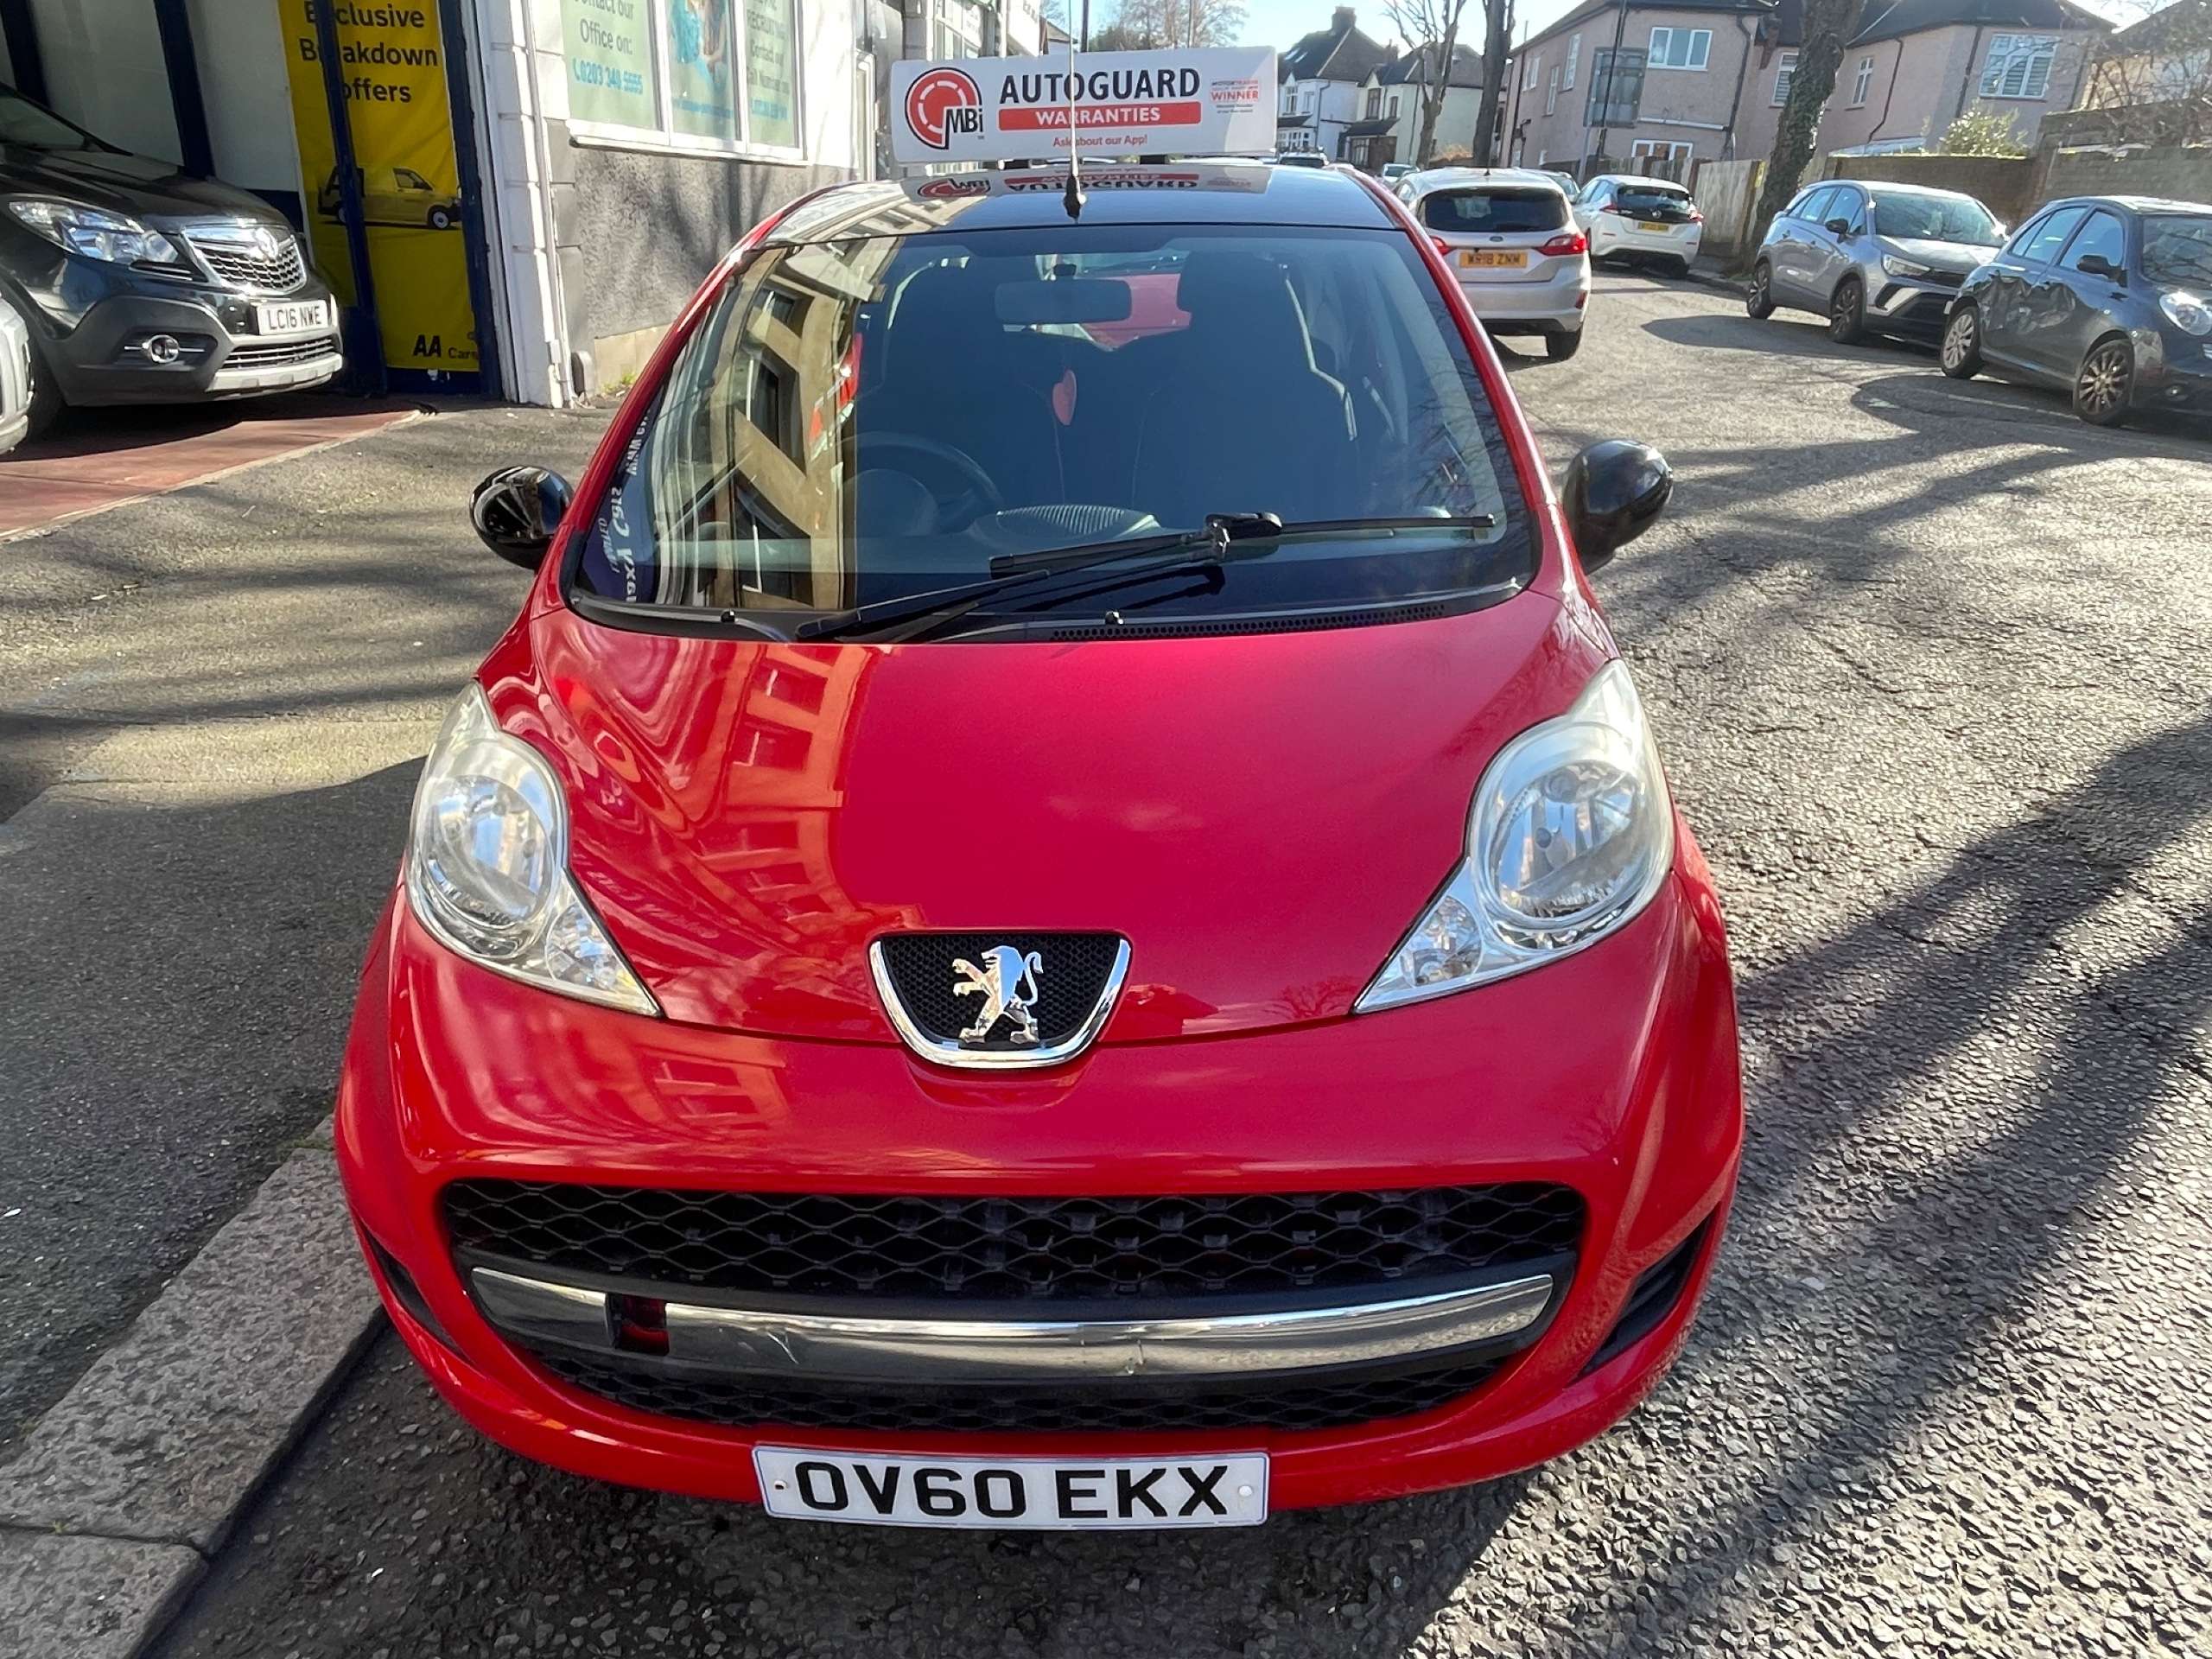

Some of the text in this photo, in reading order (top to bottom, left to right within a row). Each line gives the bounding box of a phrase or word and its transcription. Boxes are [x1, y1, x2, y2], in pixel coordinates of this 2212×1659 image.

[304, 1, 425, 28] Eclusive
[580, 18, 632, 54] Office on:
[300, 38, 438, 66] Bakdown
[344, 78, 412, 103] offers
[1000, 68, 1200, 105] AUTOGUARD
[1211, 90, 1259, 100] WINNER
[1035, 107, 1161, 125] WARRANTIES
[1105, 137, 1122, 145] our
[1123, 134, 1147, 147] App!
[267, 308, 297, 330] LC16
[413, 334, 442, 357] AA
[795, 1460, 1228, 1519] OV60 EKX
